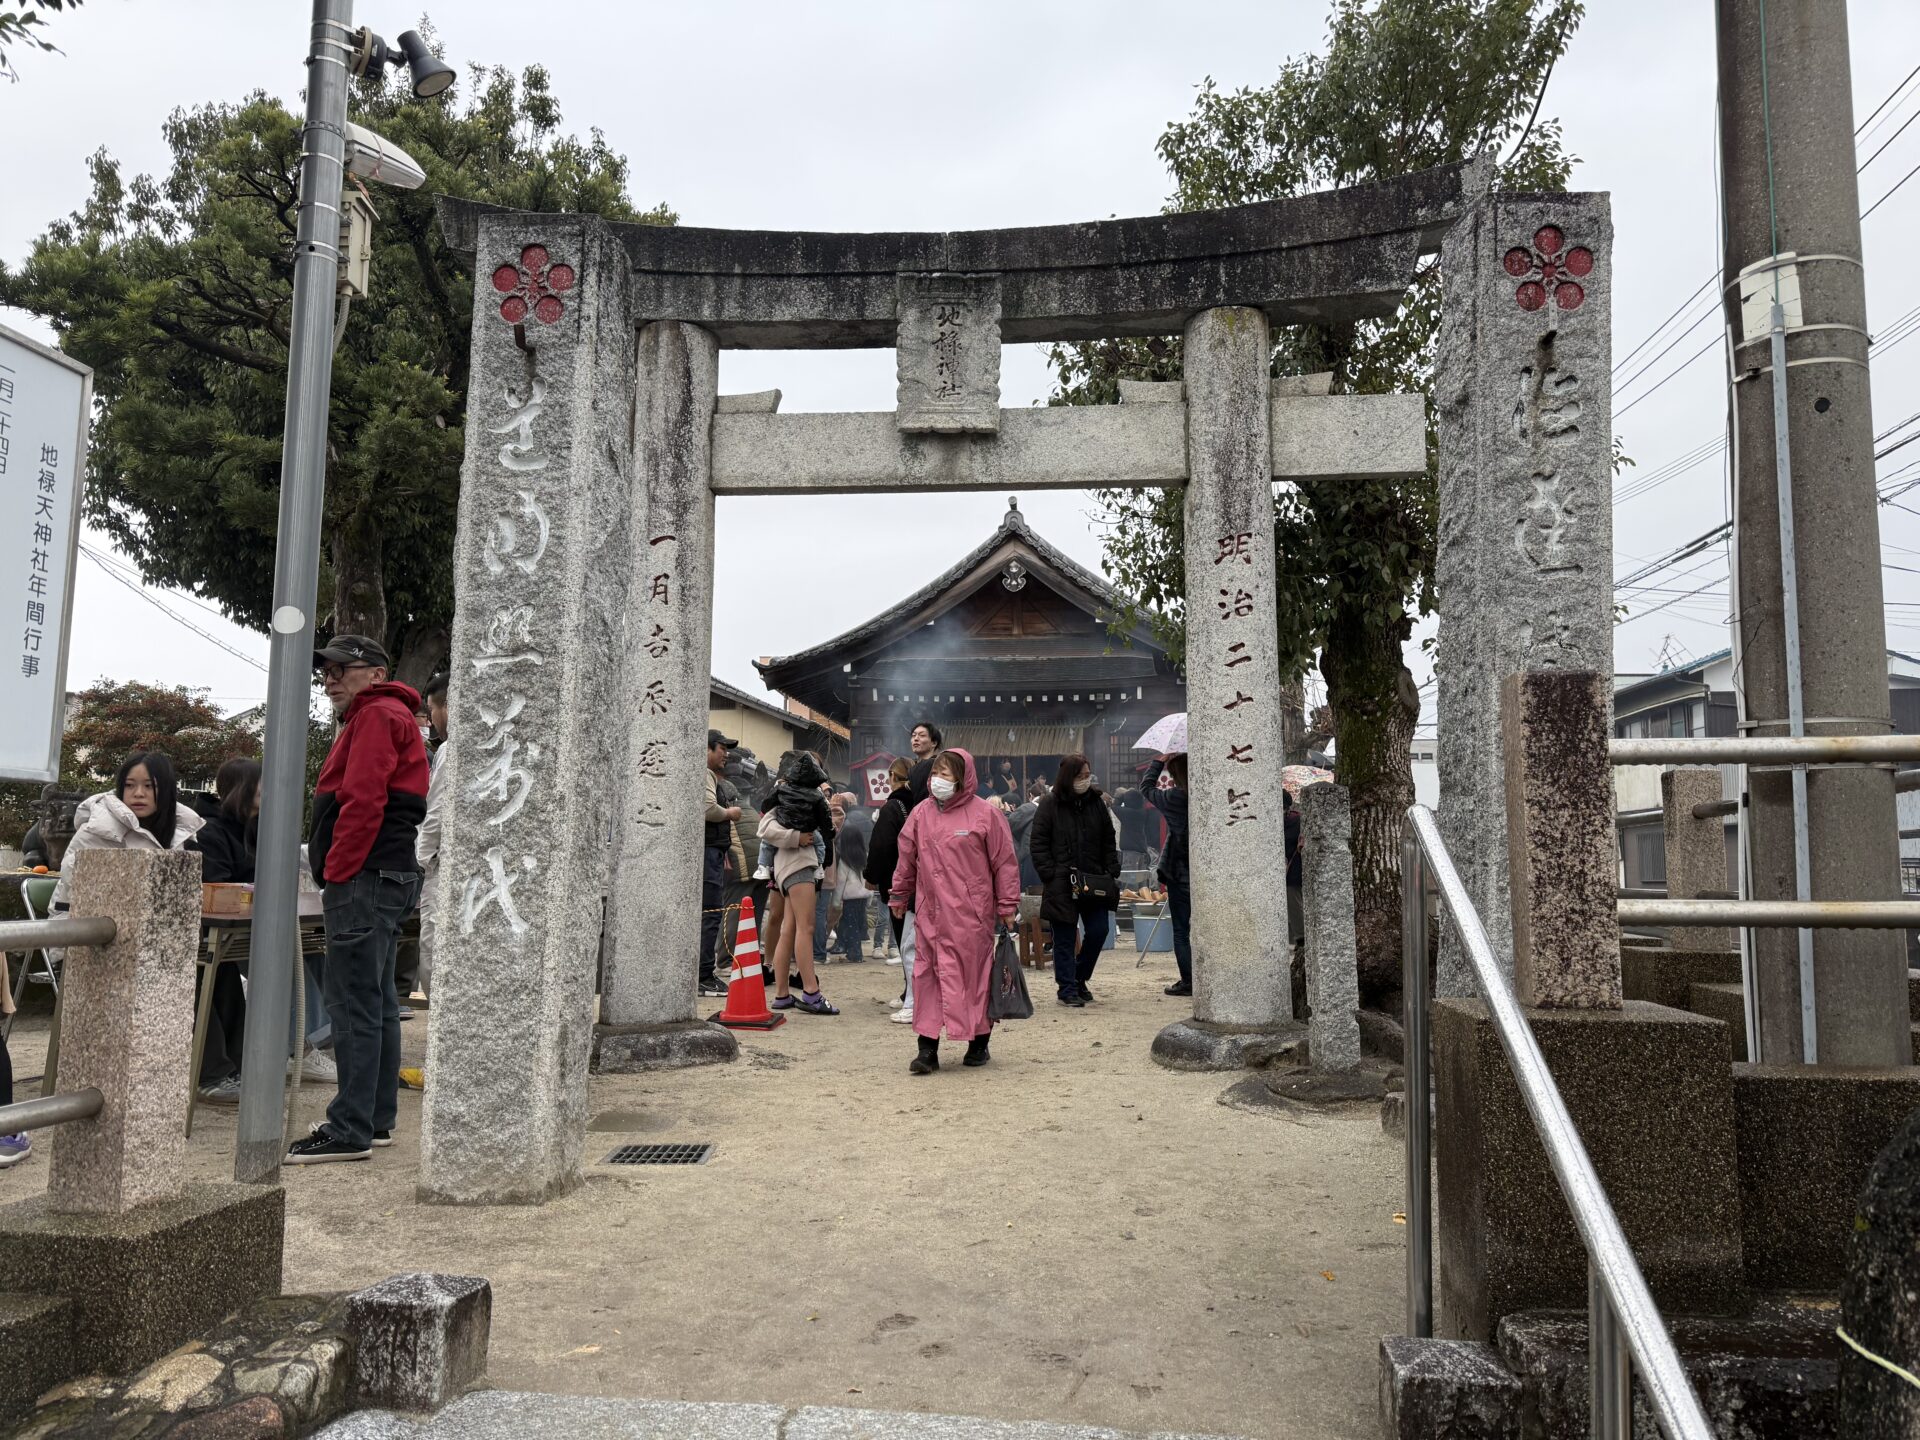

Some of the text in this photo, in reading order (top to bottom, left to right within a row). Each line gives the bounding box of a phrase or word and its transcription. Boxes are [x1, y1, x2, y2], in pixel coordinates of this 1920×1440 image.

[21, 442, 58, 679] 地禄天神社年間行事
